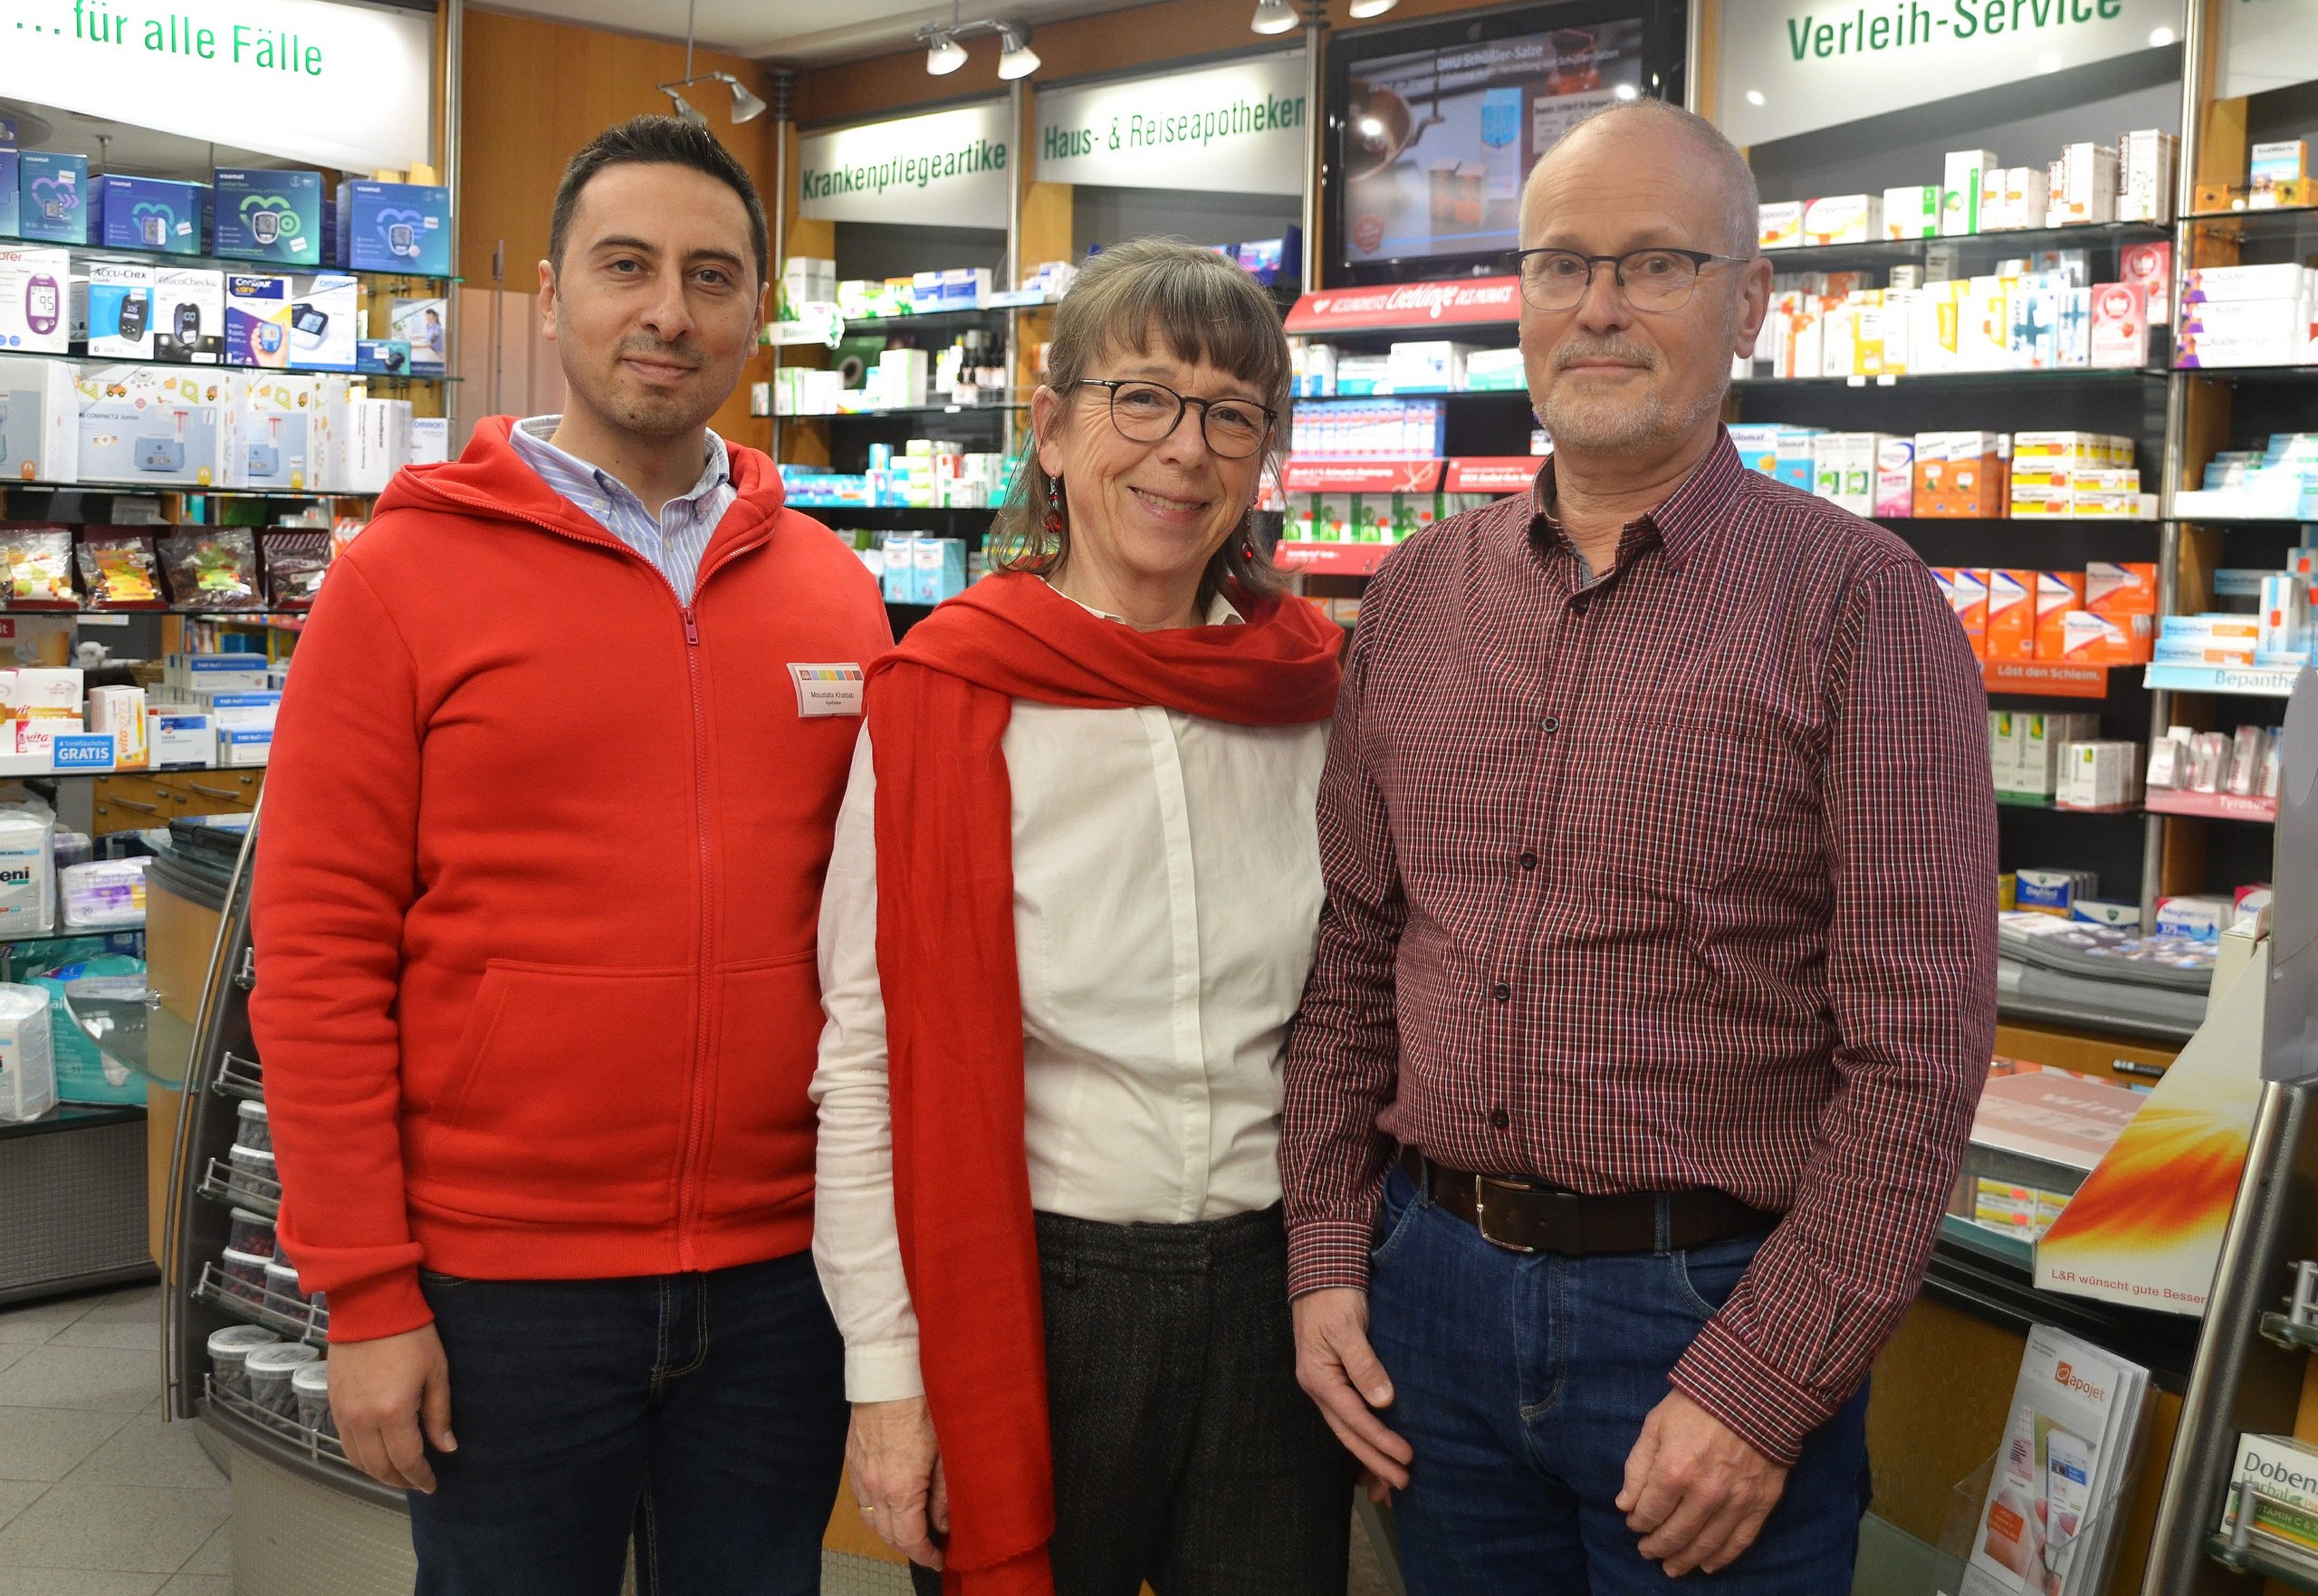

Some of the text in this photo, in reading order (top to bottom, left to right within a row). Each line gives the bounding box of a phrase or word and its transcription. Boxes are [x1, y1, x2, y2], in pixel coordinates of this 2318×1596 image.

[73, 0, 129, 45] für
[144, 14, 216, 60] alle
[234, 24, 323, 76] Fälle
[1786, 0, 2122, 62] Verleih-Service
[1044, 95, 1305, 161] Haus- & Reiseapotheken
[93, 268, 148, 280] ACCU-CHEK
[58, 748, 110, 760] GRATIS
[2052, 1269, 2206, 1305] L&R wünscht gute Besser
[2069, 1374, 2106, 1402] apojet
[2244, 1451, 2318, 1495] Doben
